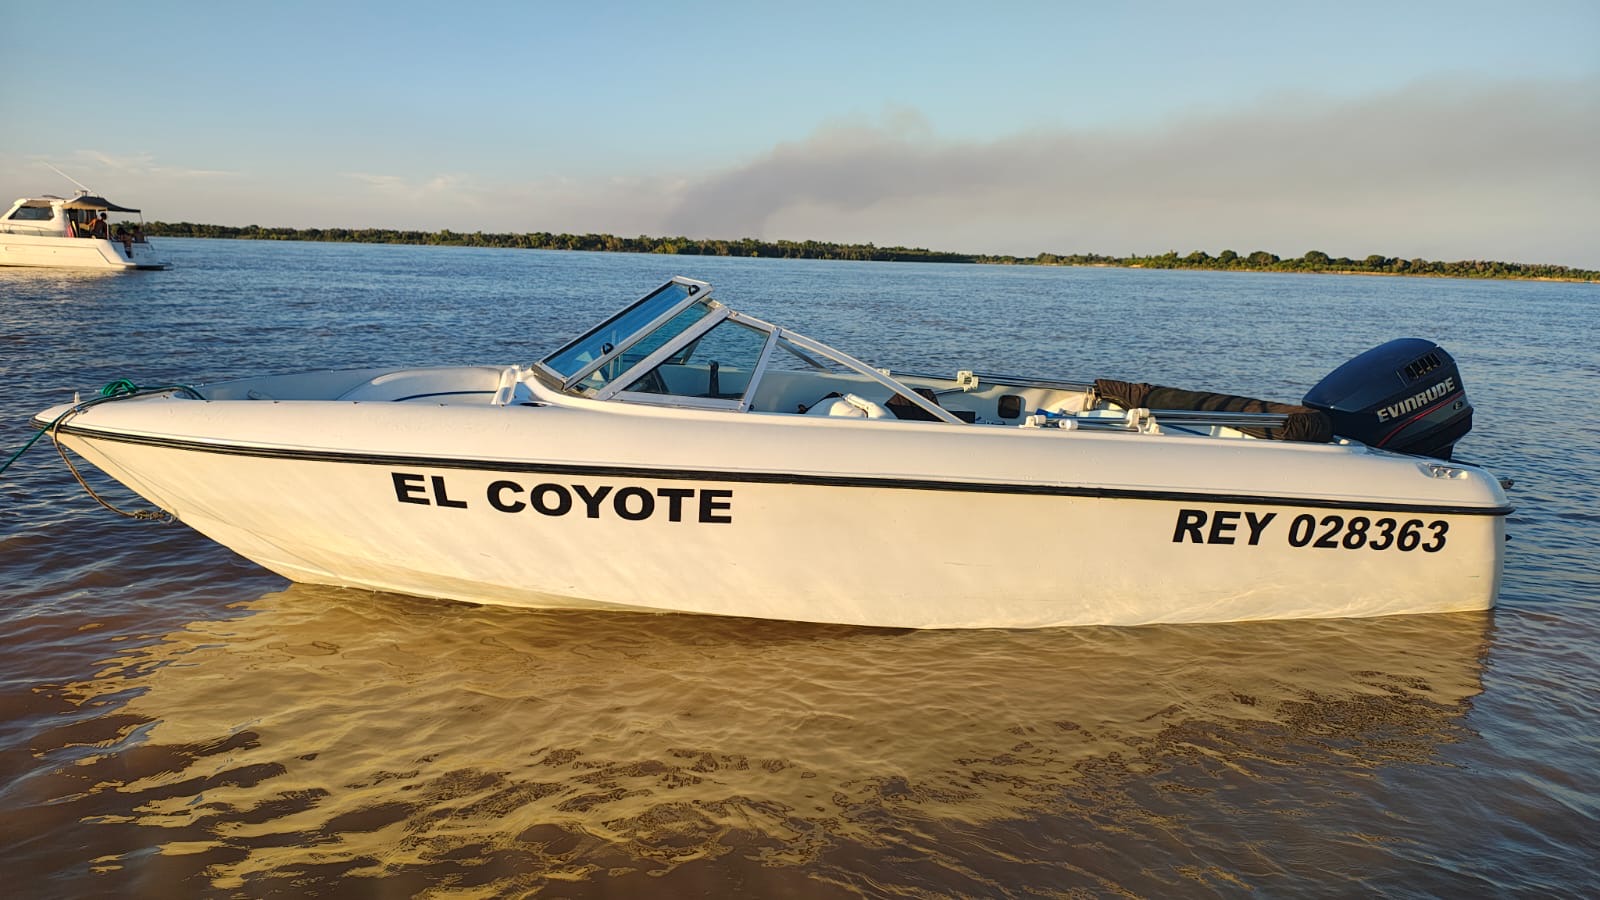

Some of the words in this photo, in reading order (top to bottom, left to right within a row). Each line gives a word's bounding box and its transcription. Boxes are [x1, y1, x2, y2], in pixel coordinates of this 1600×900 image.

[1377, 376, 1456, 423] EVINRUDE
[391, 472, 468, 509] EL
[486, 480, 733, 524] COYOTE
[1172, 508, 1278, 546] REY
[1287, 513, 1450, 553] 028363
